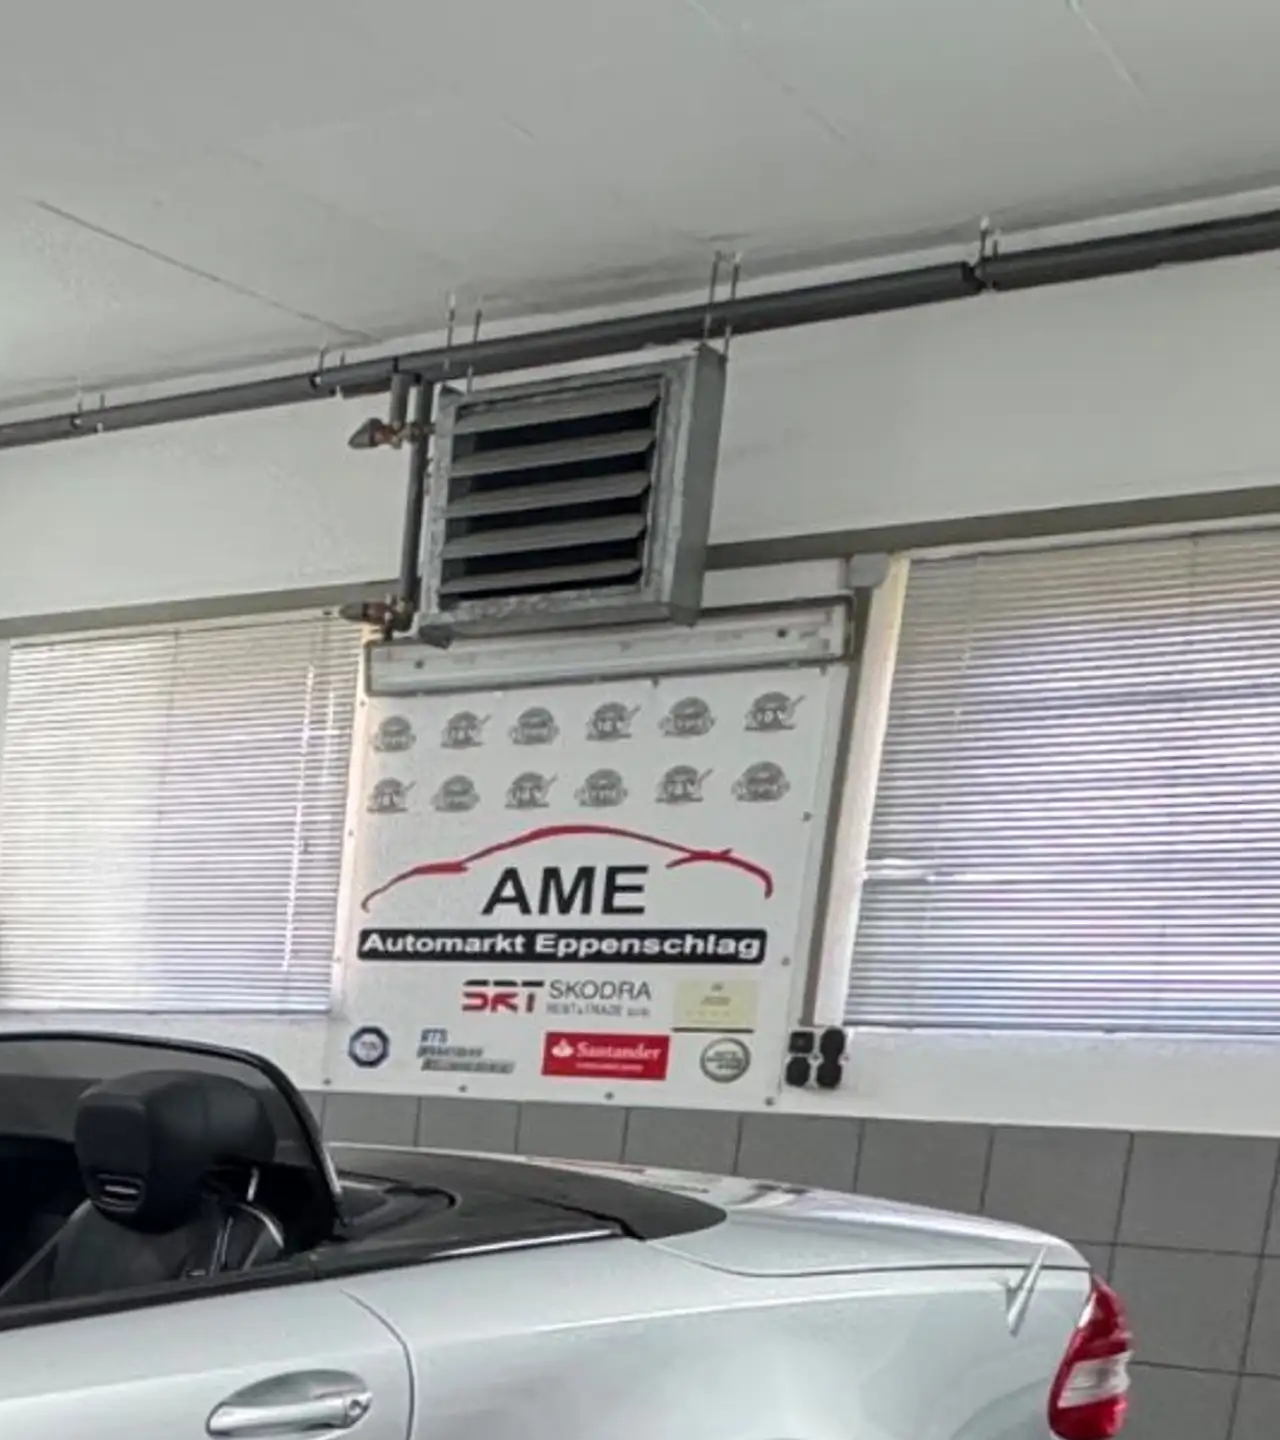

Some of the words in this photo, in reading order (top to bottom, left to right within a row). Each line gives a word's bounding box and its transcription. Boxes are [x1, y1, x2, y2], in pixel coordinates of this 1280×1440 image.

[481, 865, 648, 916] AME
[361, 932, 526, 955] Automarkt
[535, 933, 760, 963] Eppenschlag
[549, 979, 652, 1001] SKODRA
[576, 1042, 662, 1060] Santander
